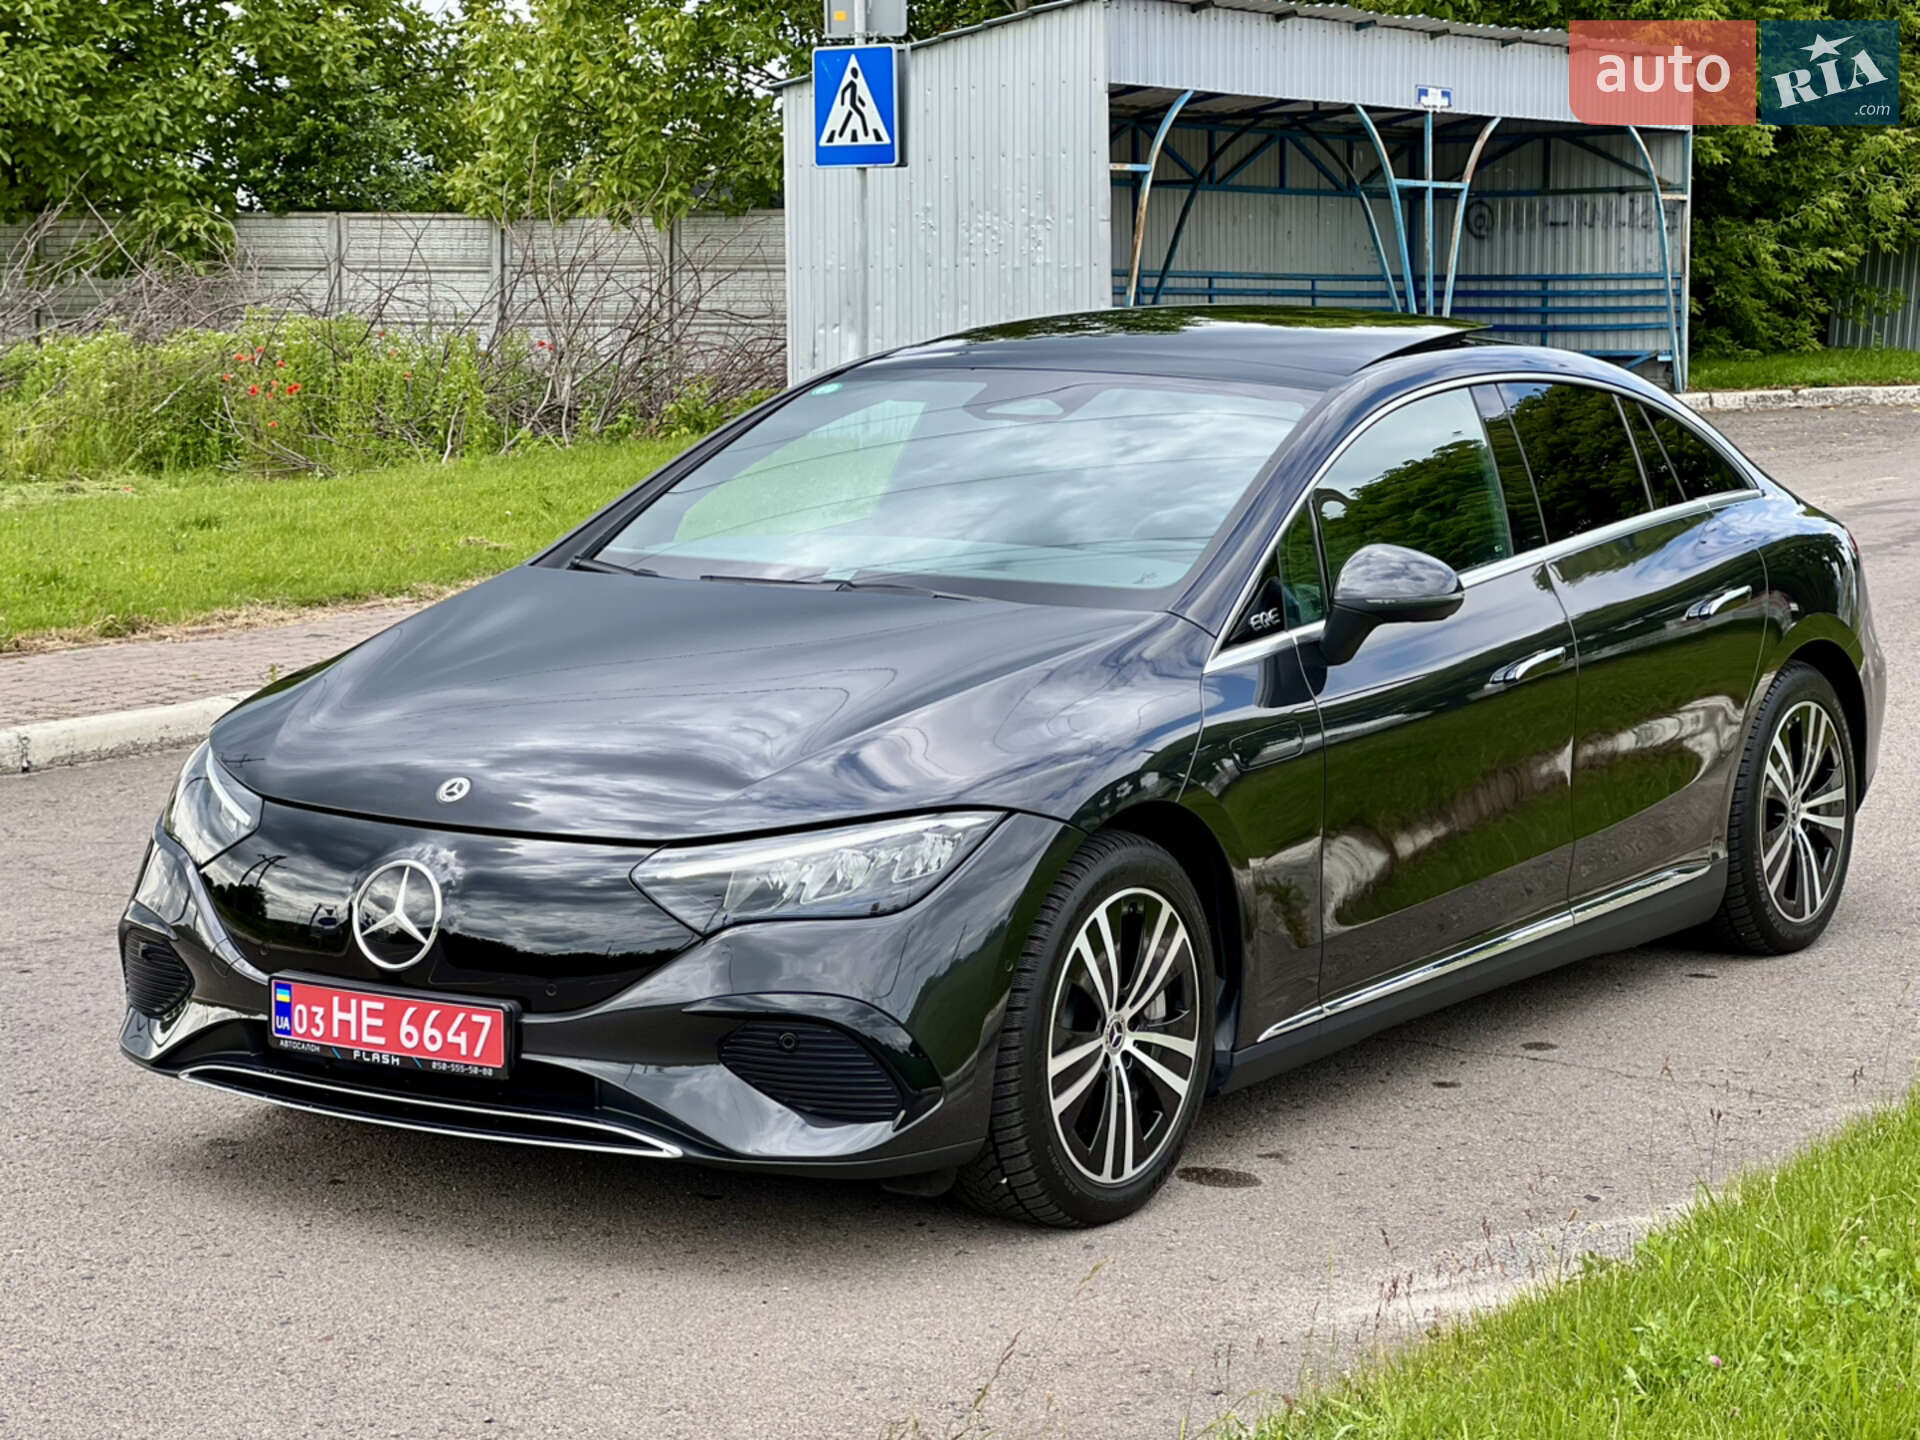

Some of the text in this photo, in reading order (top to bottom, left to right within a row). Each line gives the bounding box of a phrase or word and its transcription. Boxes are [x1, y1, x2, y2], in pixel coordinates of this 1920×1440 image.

[276, 1015, 290, 1030] UA
[399, 1007, 493, 1058] 6647
[353, 1050, 400, 1066] FLASH
